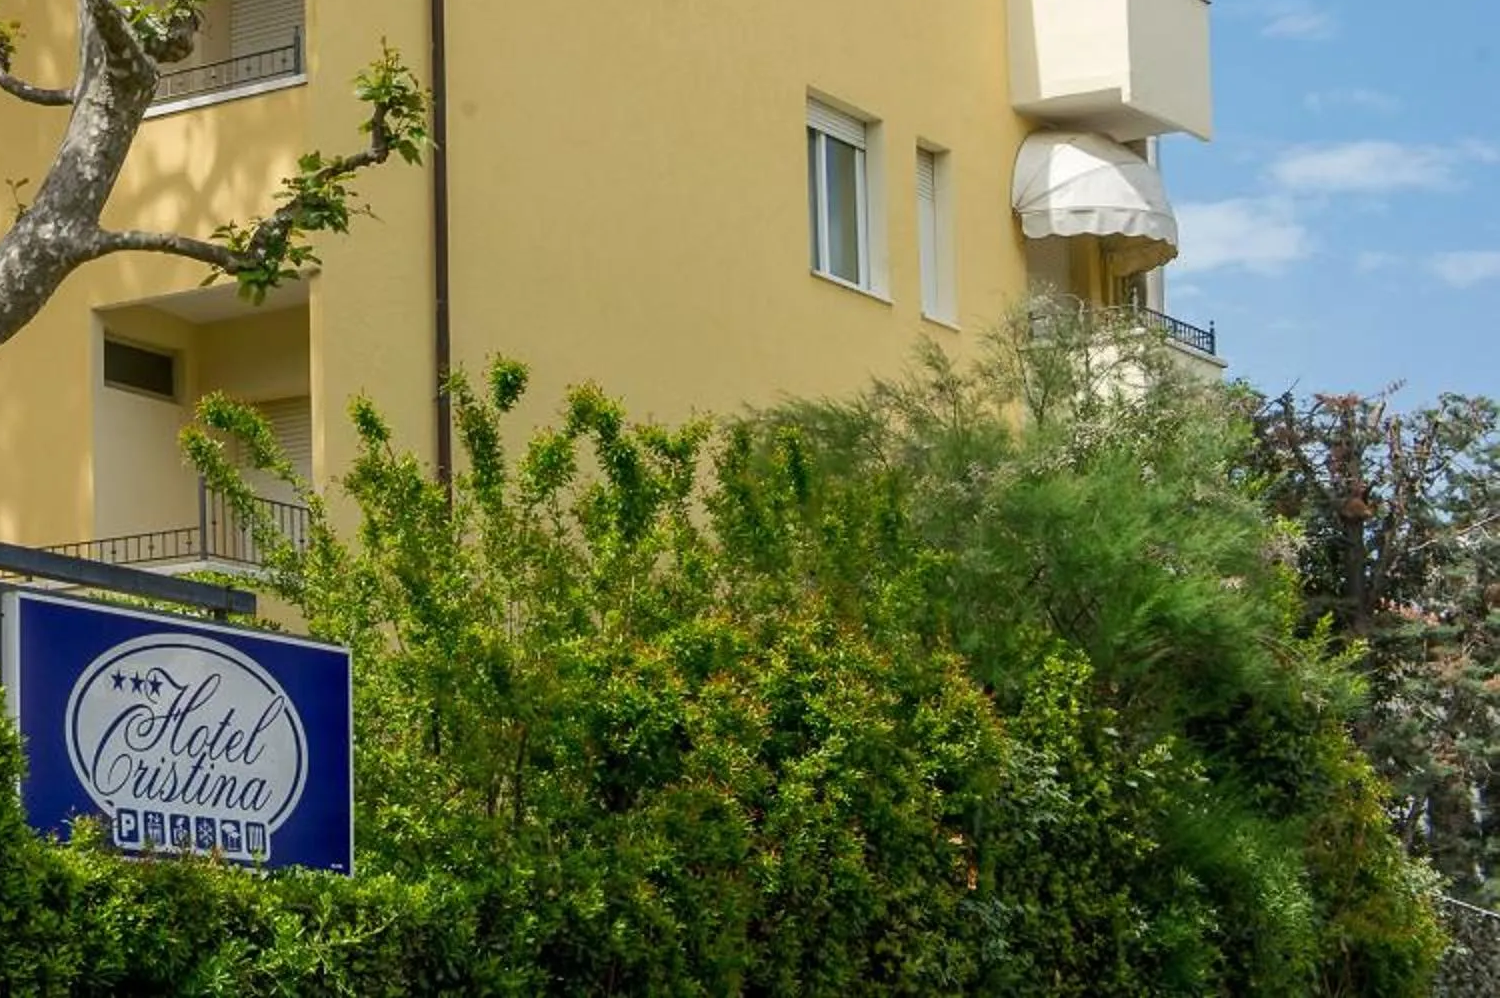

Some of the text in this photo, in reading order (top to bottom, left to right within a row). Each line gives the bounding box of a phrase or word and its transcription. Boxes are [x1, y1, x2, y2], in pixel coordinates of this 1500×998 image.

[92, 704, 273, 811] Cristina
[123, 667, 285, 765] Hotel
[120, 813, 135, 838] P
